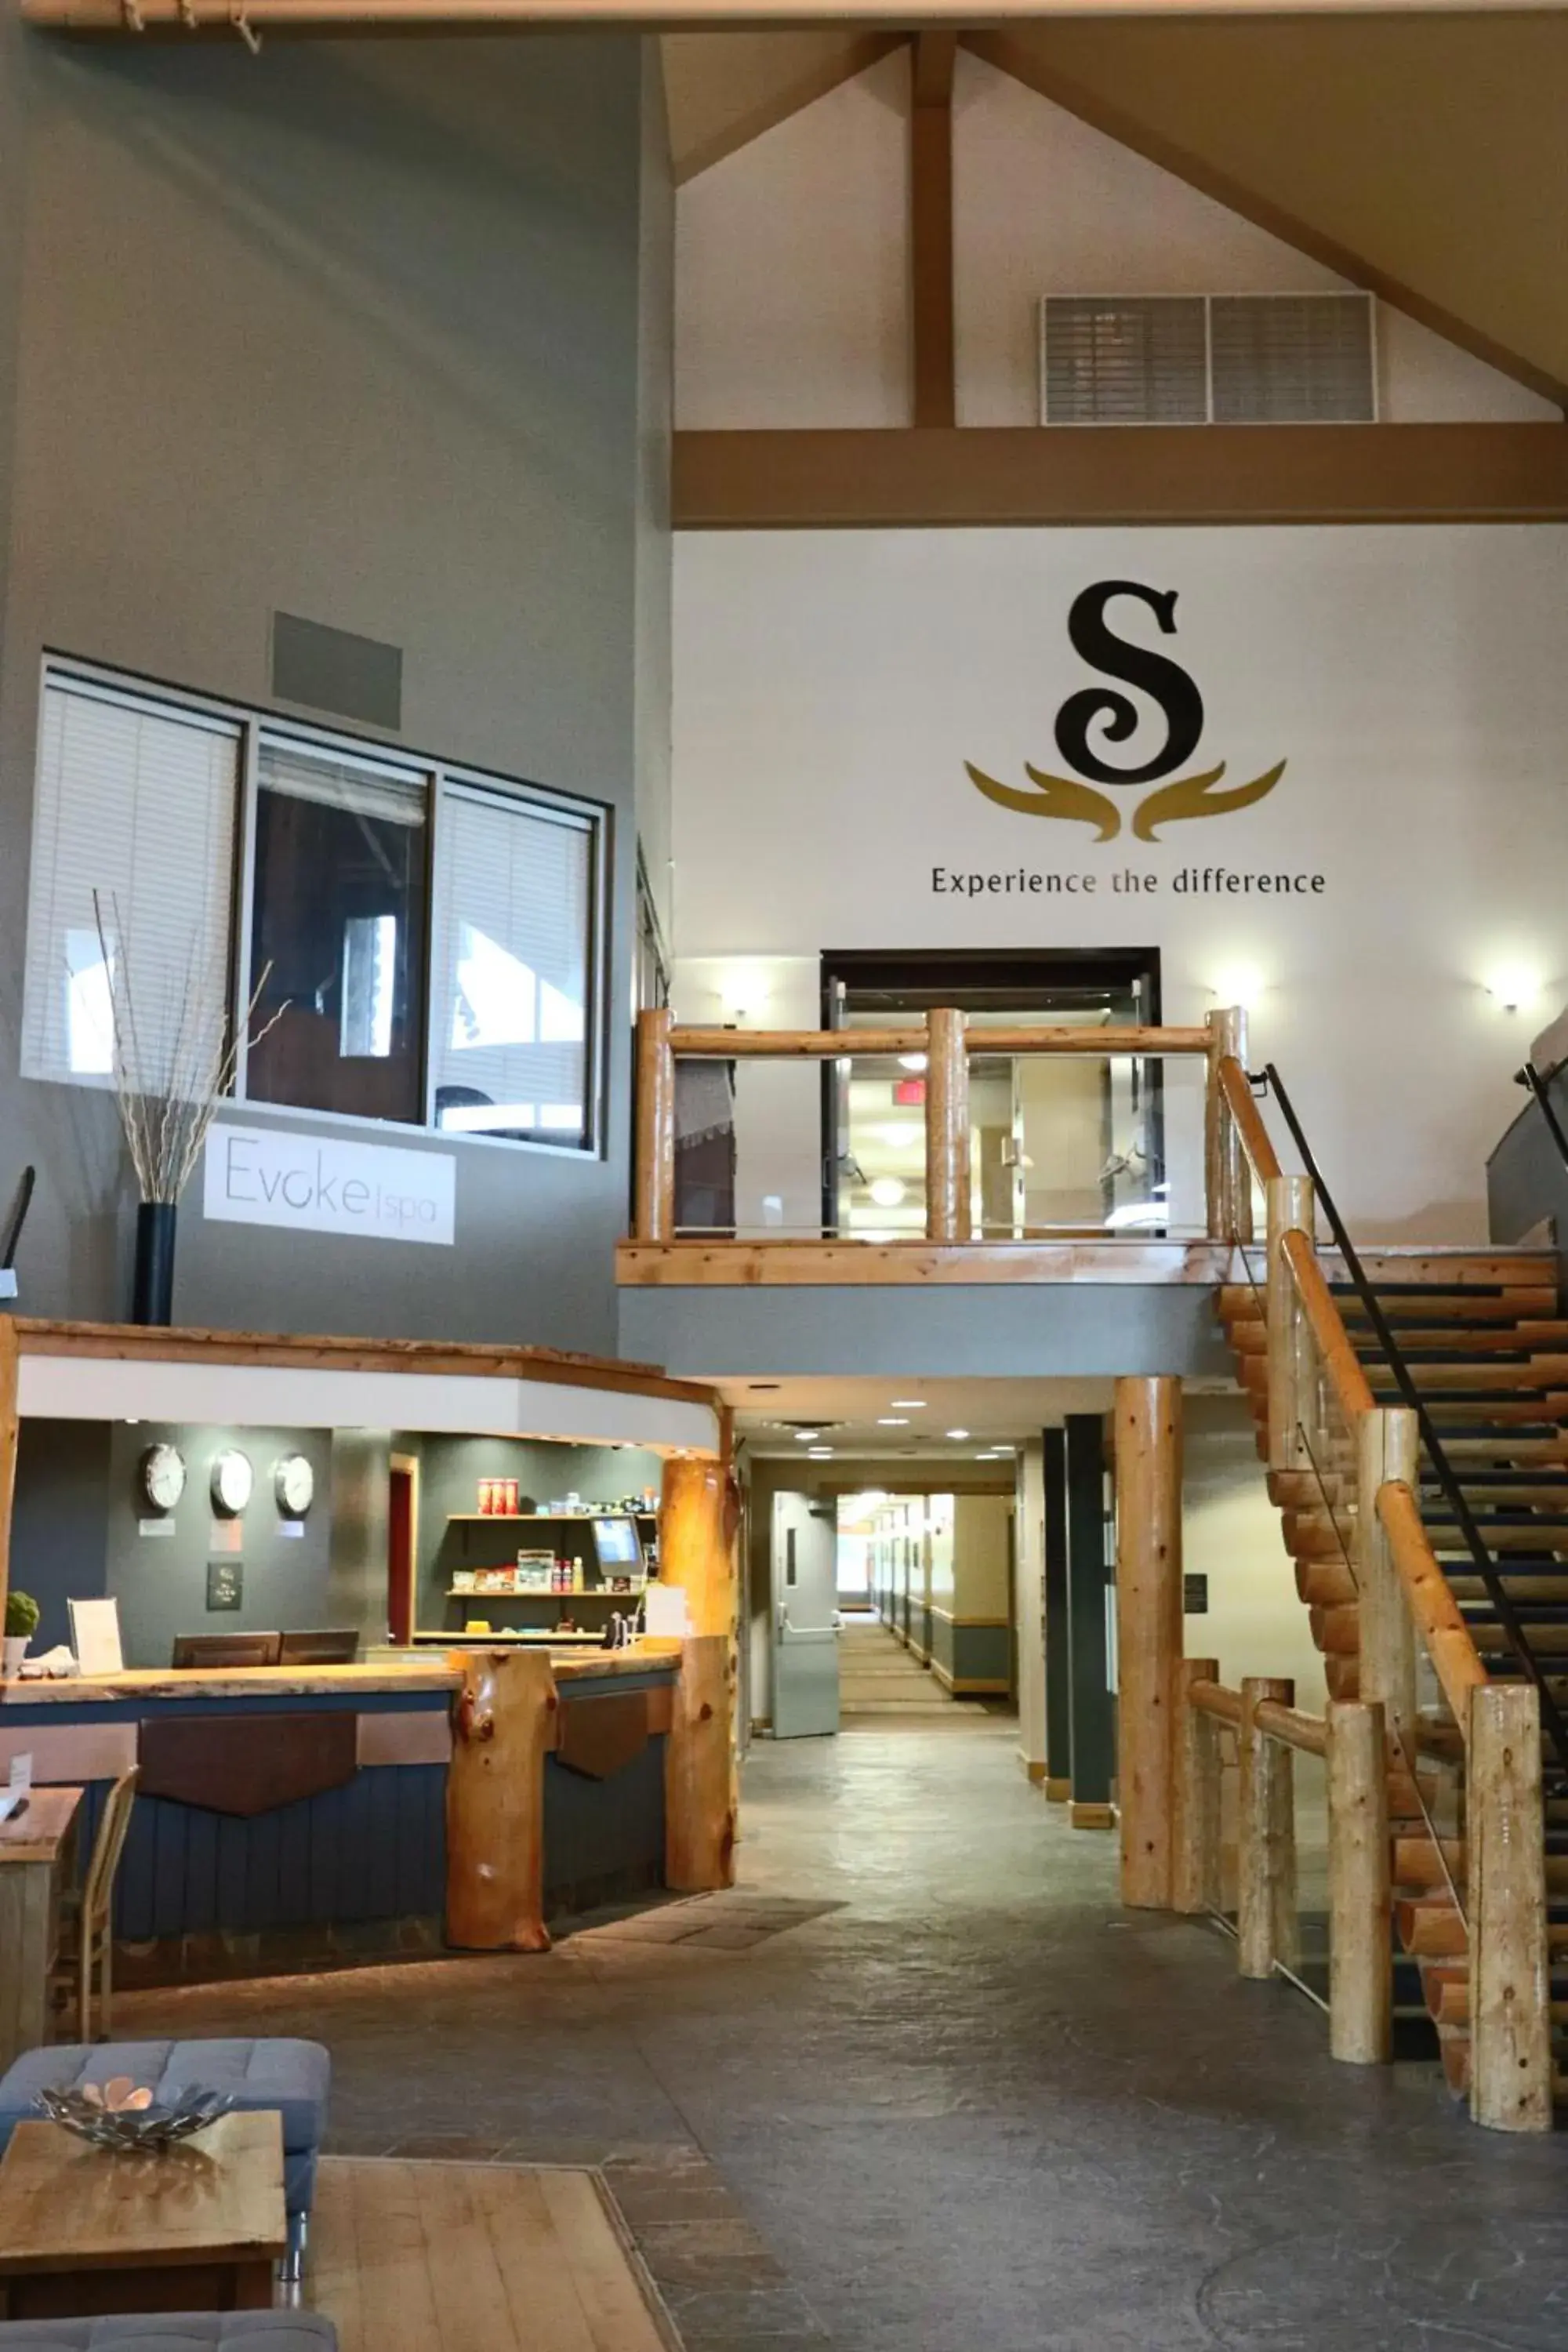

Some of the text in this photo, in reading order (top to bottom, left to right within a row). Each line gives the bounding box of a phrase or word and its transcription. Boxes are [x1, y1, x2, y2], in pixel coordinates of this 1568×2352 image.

[1054, 580, 1204, 785] S
[931, 868, 1326, 897] Experience the difference
